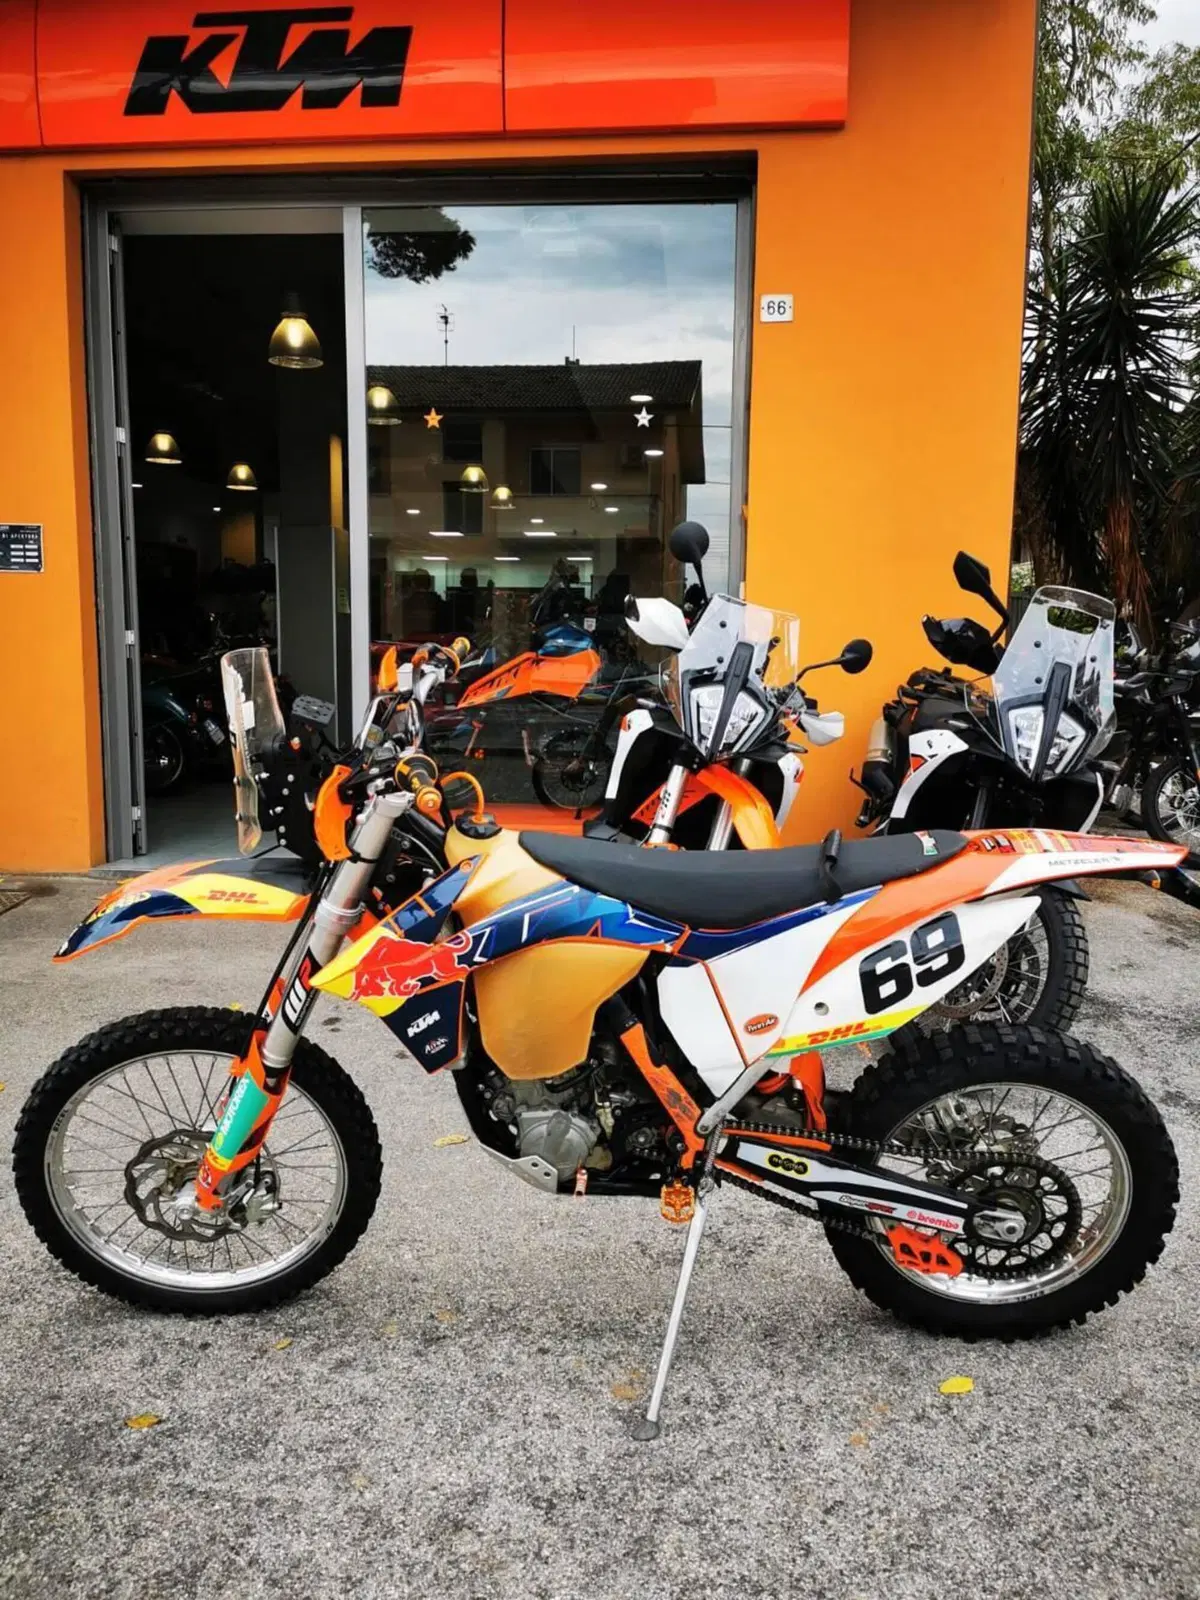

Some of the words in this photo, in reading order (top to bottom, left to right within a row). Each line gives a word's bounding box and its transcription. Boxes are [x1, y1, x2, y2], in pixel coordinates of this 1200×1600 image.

[123, 6, 413, 116] KTM
[767, 300, 787, 316] 66
[207, 889, 260, 905] DHL
[859, 910, 965, 1015] 69
[406, 1009, 441, 1038] KTM
[807, 1022, 871, 1046] DHL
[220, 1076, 250, 1136] MOTOREX
[916, 1212, 960, 1231] brembo
